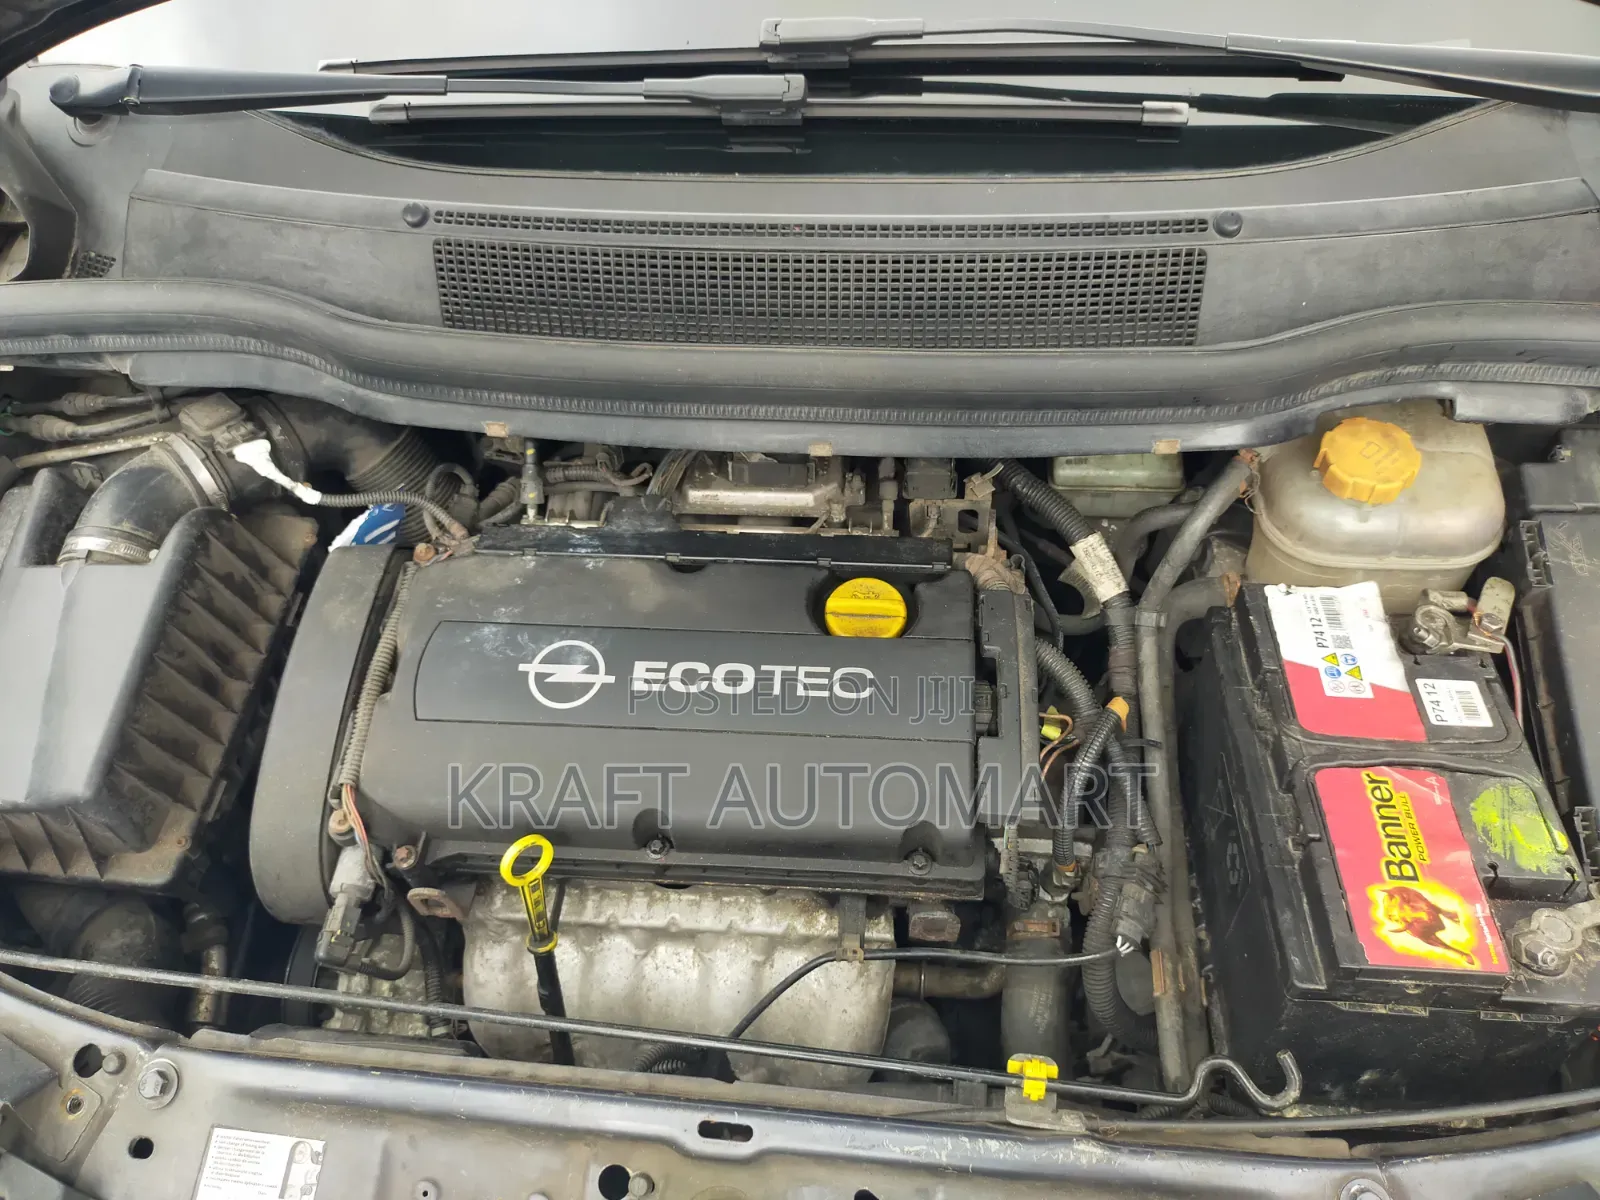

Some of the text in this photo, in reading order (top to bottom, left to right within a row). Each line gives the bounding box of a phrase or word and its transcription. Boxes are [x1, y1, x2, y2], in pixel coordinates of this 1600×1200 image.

[1309, 617, 1323, 628] 12
[1313, 631, 1330, 648] P74
[631, 660, 875, 699] ECOTEC
[1423, 683, 1449, 723] P74 12
[1364, 771, 1420, 883] Banner
[1398, 794, 1427, 862] POWER BULL
